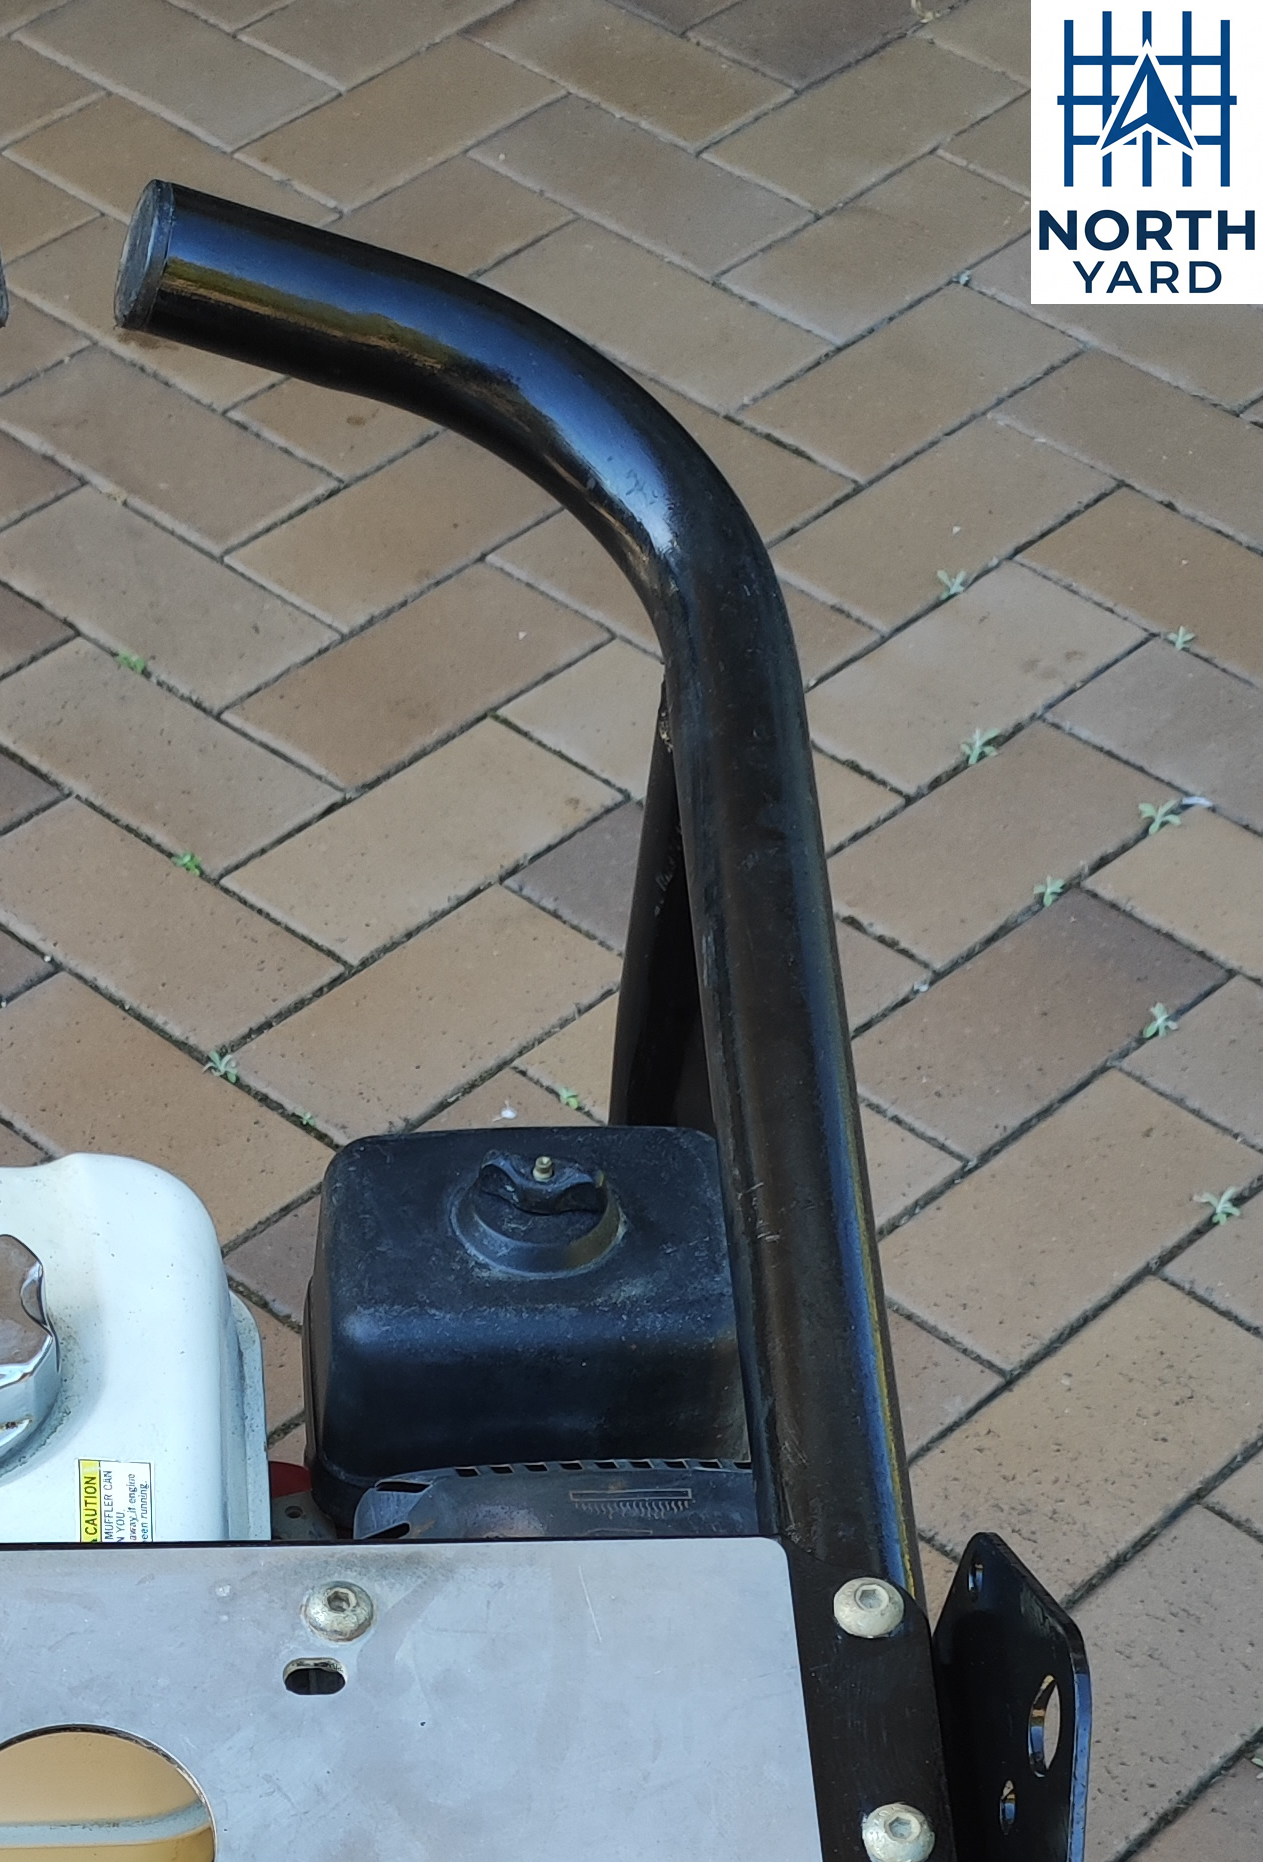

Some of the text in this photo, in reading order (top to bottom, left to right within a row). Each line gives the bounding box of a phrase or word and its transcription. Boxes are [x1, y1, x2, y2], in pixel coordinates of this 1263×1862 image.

[84, 1476, 97, 1535] CAUTION
[102, 1470, 114, 1540] MUFFLER CAN
[129, 1516, 139, 1541] away
[140, 1522, 149, 1542] een
